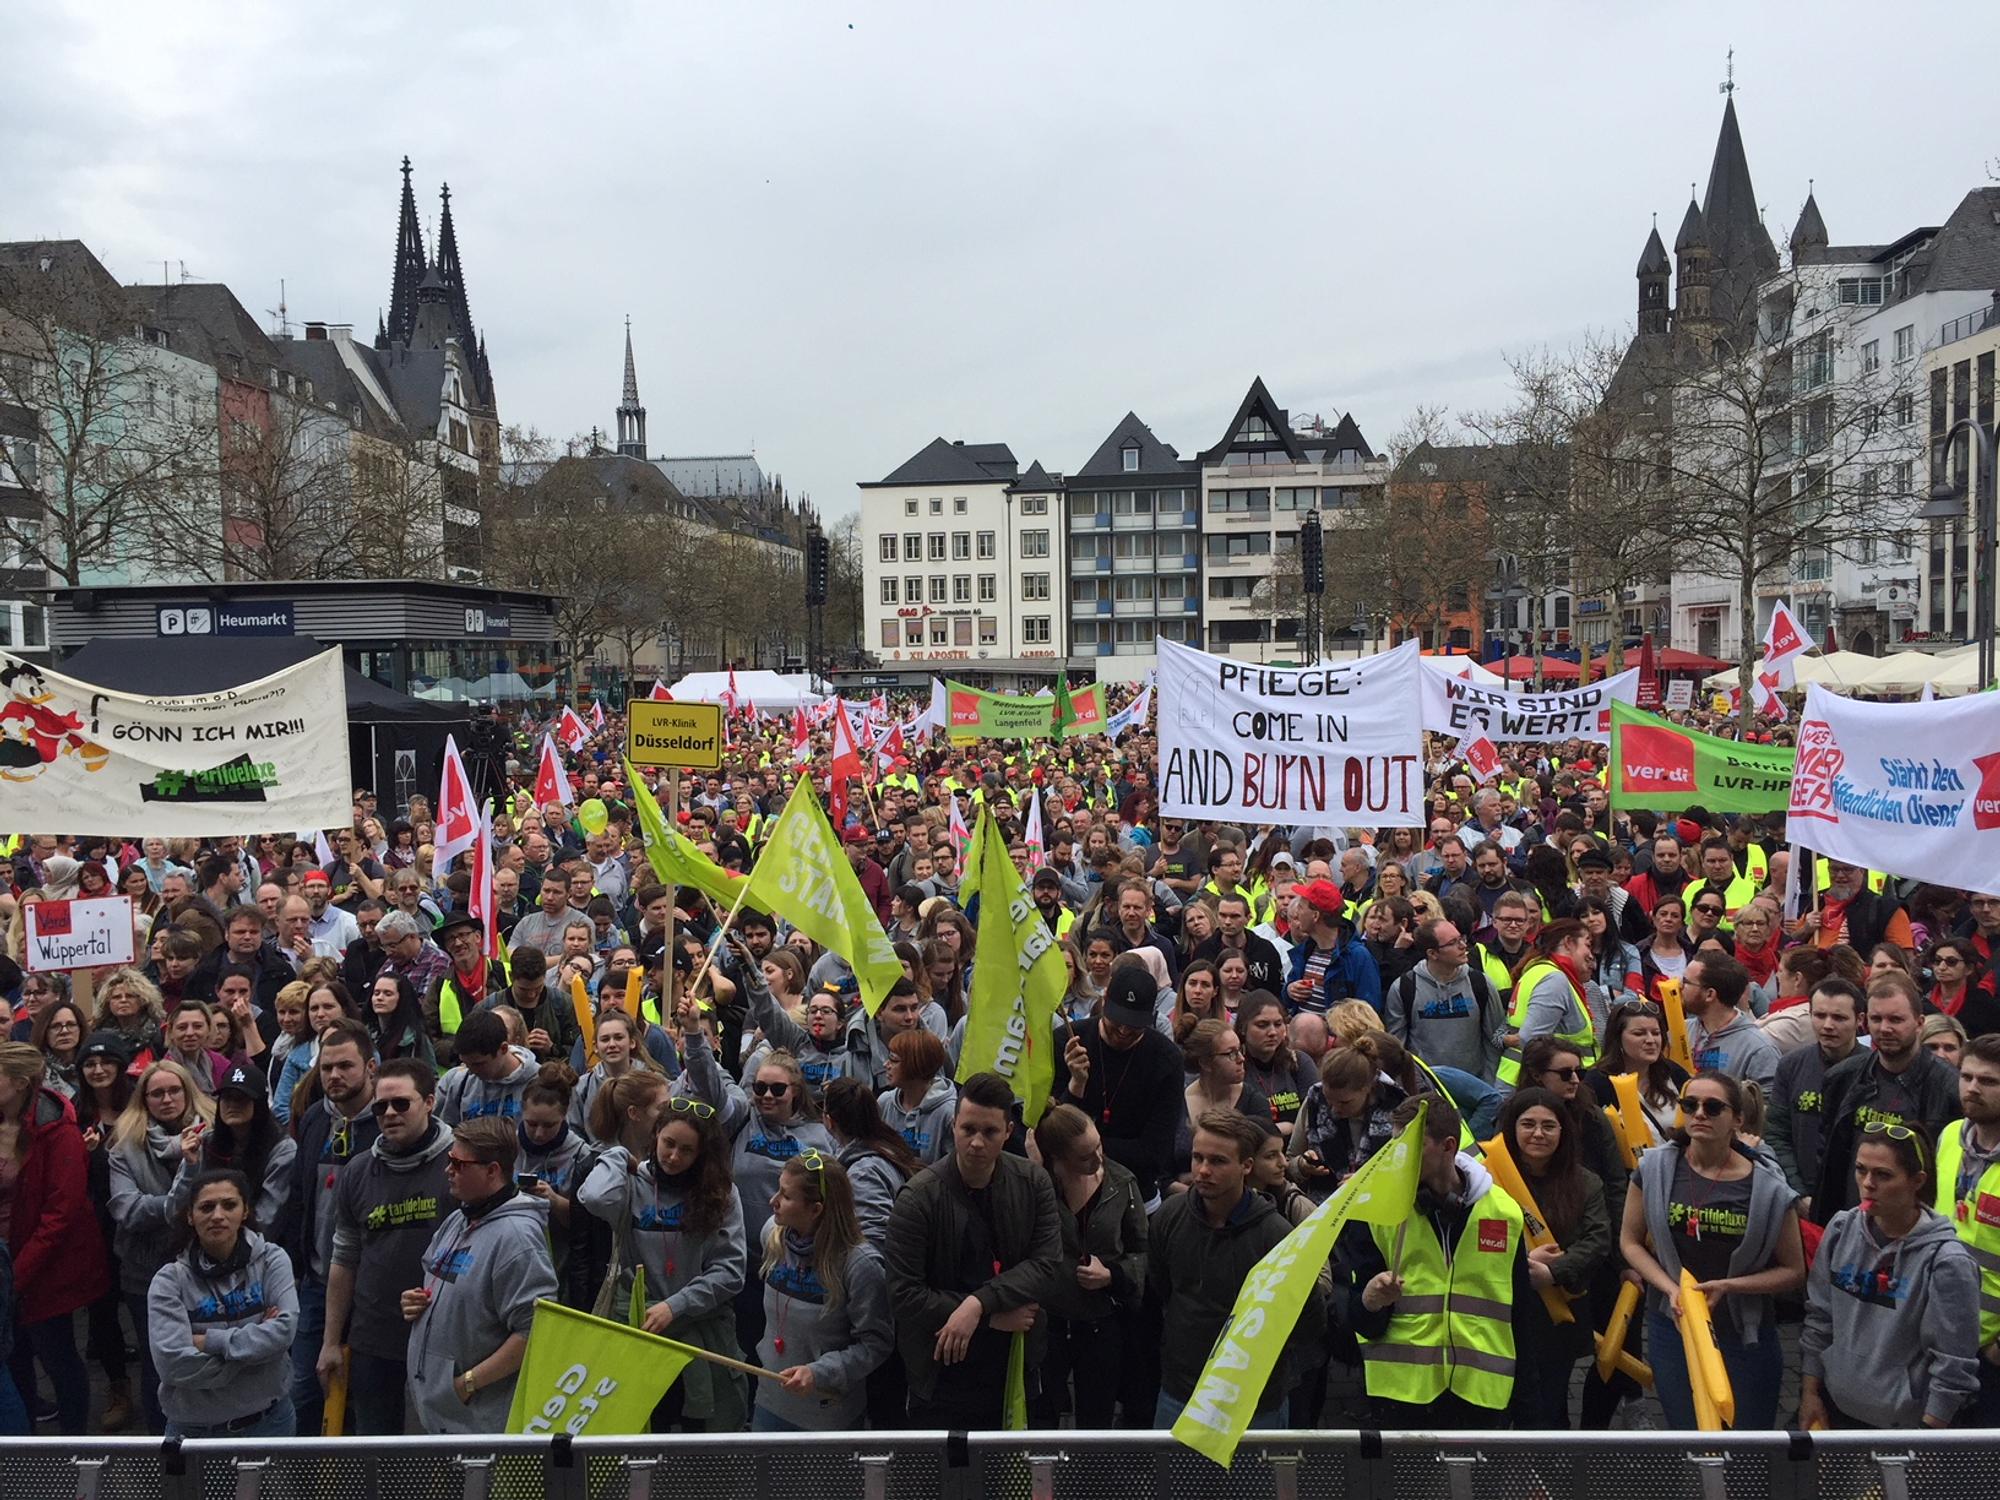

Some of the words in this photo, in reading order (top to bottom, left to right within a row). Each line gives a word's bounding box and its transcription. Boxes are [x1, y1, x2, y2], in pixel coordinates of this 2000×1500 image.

[219, 612, 287, 627] Heumarkt
[897, 608, 917, 618] GAG
[909, 652, 924, 660] XII
[928, 651, 970, 660] APOSTEL
[1219, 662, 1363, 696] PFLEGE:
[1446, 678, 1506, 709] WIR
[1518, 688, 1602, 713] SIND
[652, 717, 697, 729] LVR-Klinik
[952, 710, 978, 721] ver.di
[995, 718, 1042, 727] Langenfeld
[1232, 710, 1303, 742] COME
[1316, 713, 1349, 743] IN
[1449, 703, 1490, 732] ES
[1501, 710, 1592, 736] WERT.
[112, 721, 182, 742] GÖNN
[192, 726, 235, 742] ICH
[245, 717, 305, 741] MIR!!!
[635, 733, 715, 751] Düsseldorf
[153, 760, 277, 797] #tarifdeluxe
[1163, 747, 1234, 807] AND
[1241, 752, 1327, 812] BURN
[1343, 755, 1418, 813] OUT
[1626, 763, 1689, 783] ver.di
[1713, 774, 1792, 793] LVR-HP
[1879, 756, 1929, 792] Stärkt
[1930, 757, 1966, 792] den
[1831, 773, 1904, 825] öffentlichen
[1906, 793, 1965, 828] Dienst
[367, 1196, 437, 1231] #tarifdeluxe
[1480, 1238, 1505, 1249] ver.di
